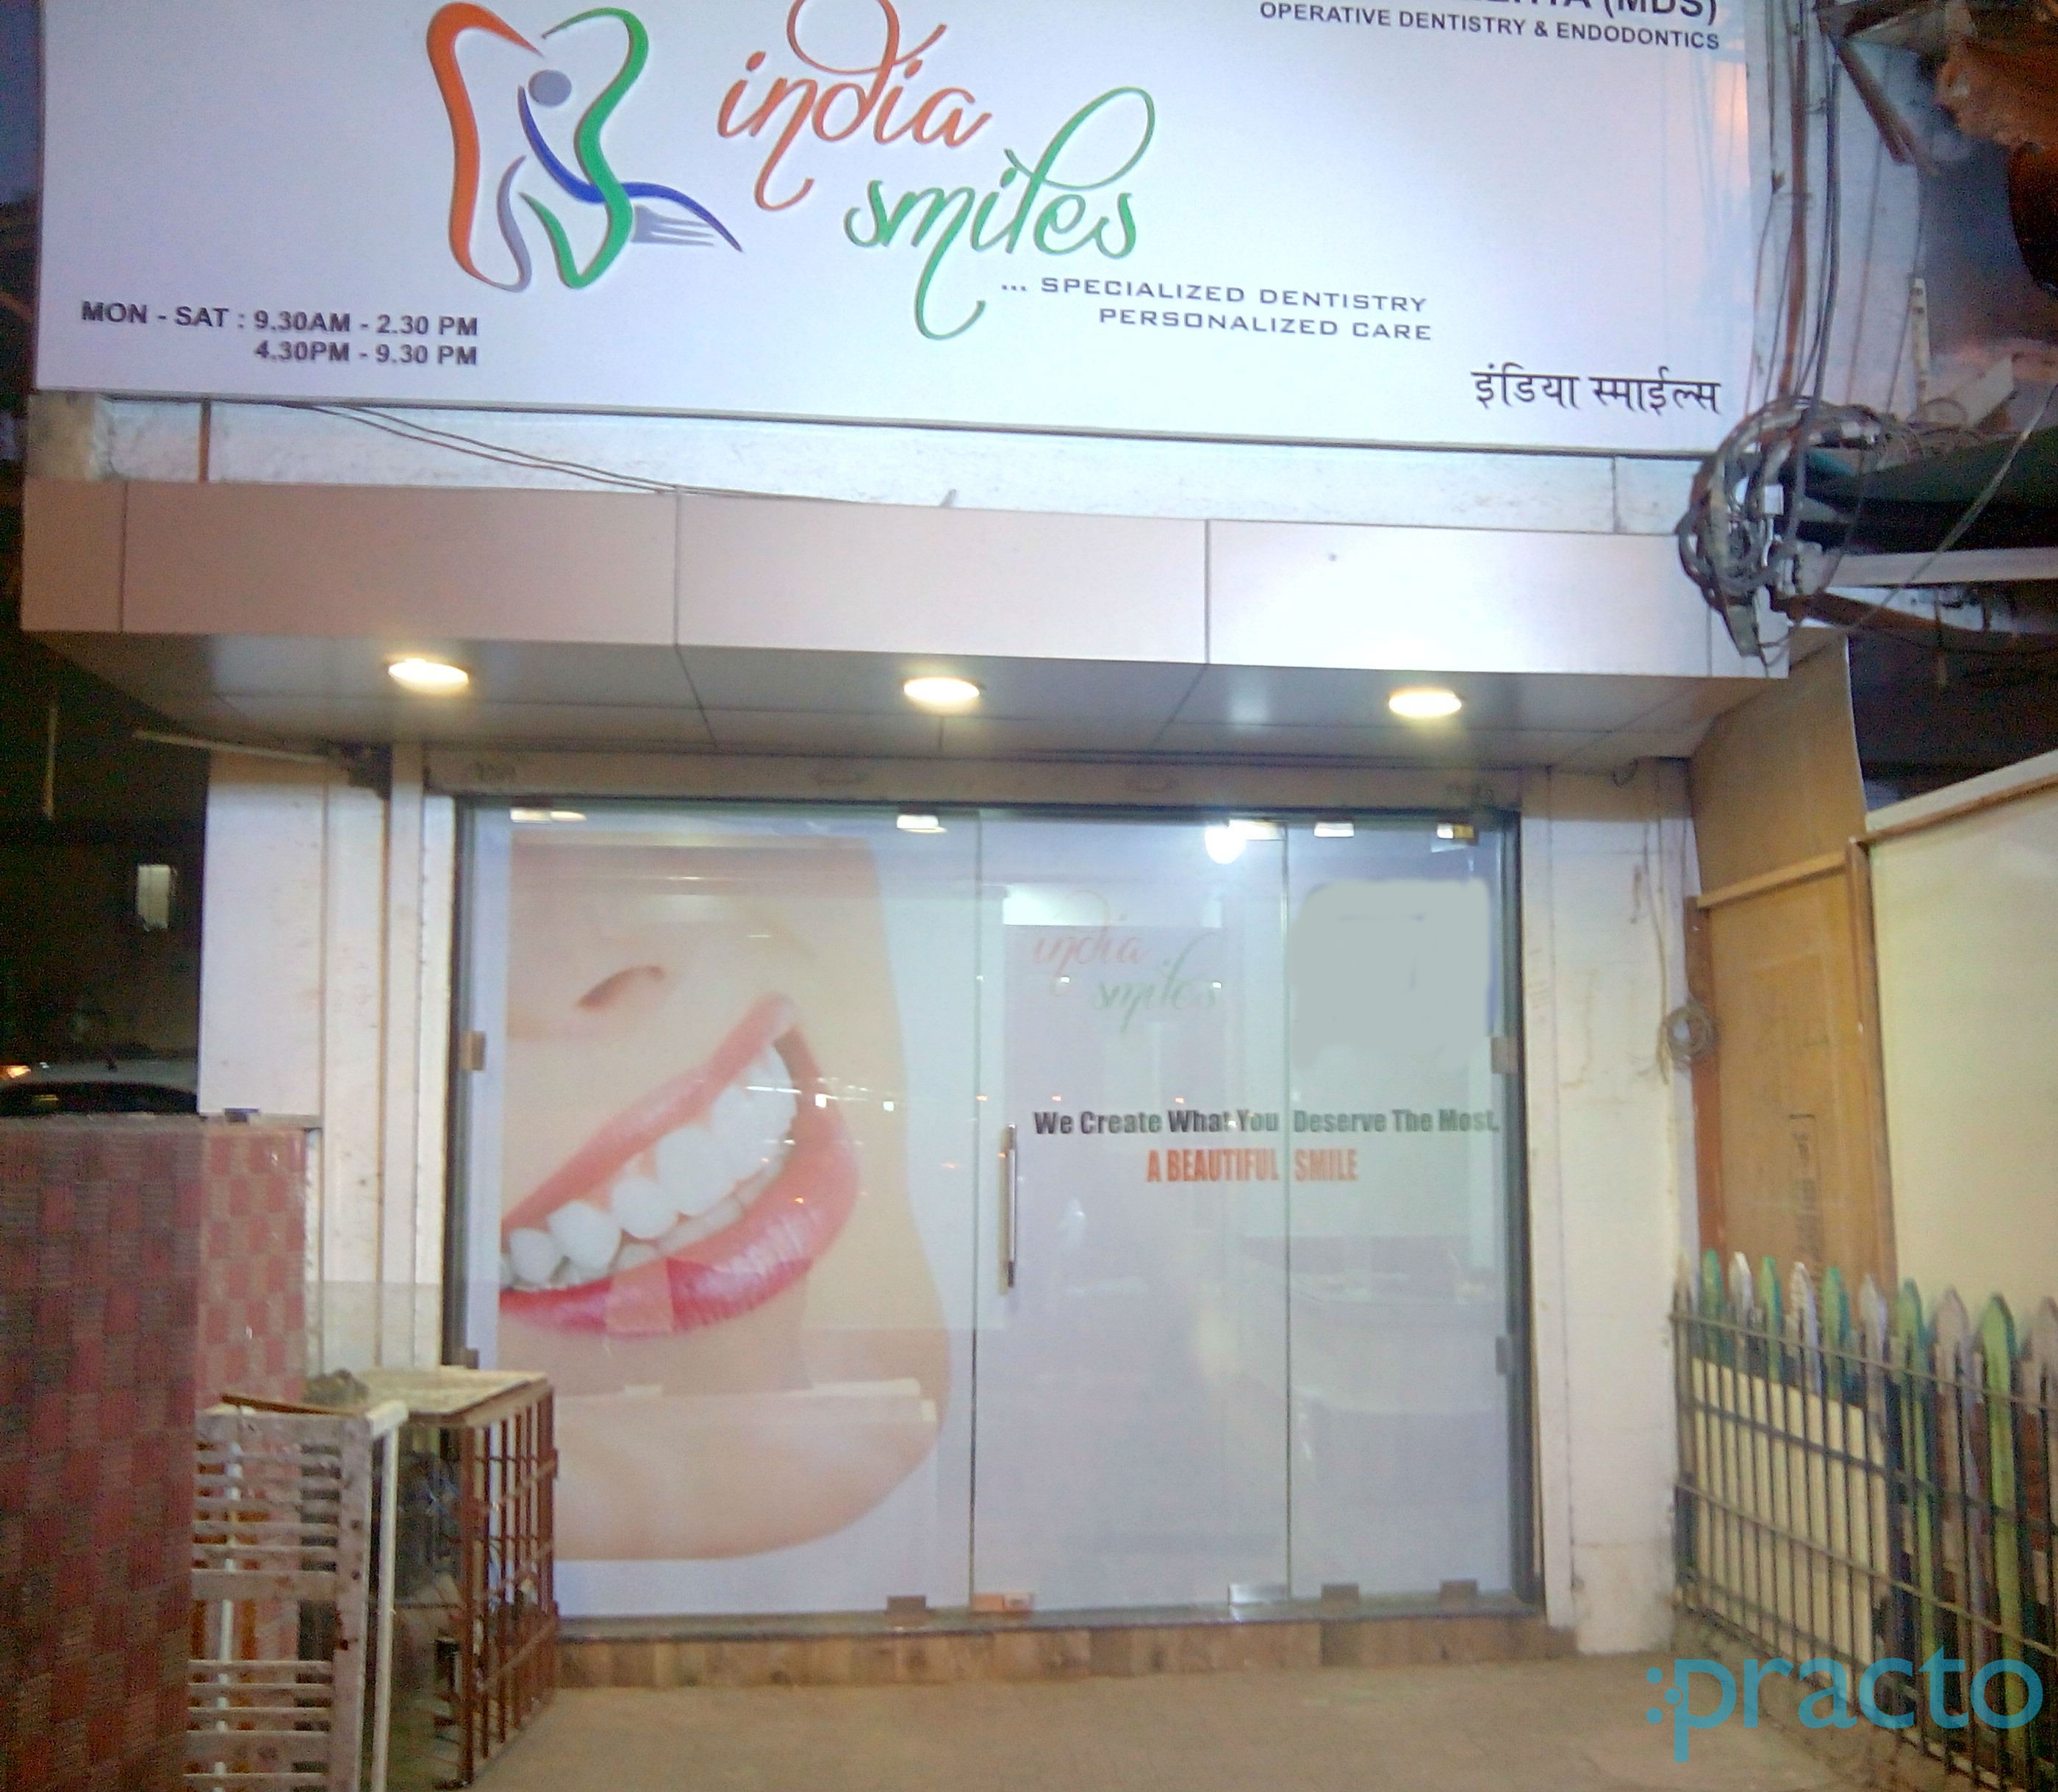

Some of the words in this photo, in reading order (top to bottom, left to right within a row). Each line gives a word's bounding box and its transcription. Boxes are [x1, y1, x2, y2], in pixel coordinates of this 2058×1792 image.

[1260, 1, 1391, 26] OPERATIVE
[1399, 10, 1526, 36] DENTISTRY
[1534, 20, 1549, 37] &
[1556, 22, 1720, 50] ENDODONTICS
[717, 0, 992, 211] india
[844, 87, 1155, 340] smiles
[1041, 277, 1245, 302] SPECIALIZED
[1259, 289, 1427, 312] DENTISTRY
[81, 301, 148, 324] MON
[174, 306, 229, 328] SAT
[254, 309, 351, 333] 9.30AM
[376, 314, 429, 335] 2.30
[438, 317, 478, 337] PM
[1100, 307, 1338, 336] PERSONALIZED
[1352, 322, 1431, 340] CARE
[254, 340, 350, 362] 4.30PM
[375, 343, 429, 365] 9.30
[437, 345, 477, 366] PM
[1470, 362, 1580, 409] इंडिया
[1588, 365, 1721, 415] स्माईल्स
[1034, 1111, 1073, 1134] We
[1080, 1111, 1163, 1134] Create
[1167, 1109, 1230, 1133] What
[1236, 1108, 1280, 1132] You
[1293, 1110, 1387, 1133] Deserve
[1392, 1108, 1433, 1133] The
[1147, 1148, 1162, 1182] A
[1166, 1147, 1280, 1182] BEAUTIFUL
[1294, 1147, 1358, 1182] SMILE
